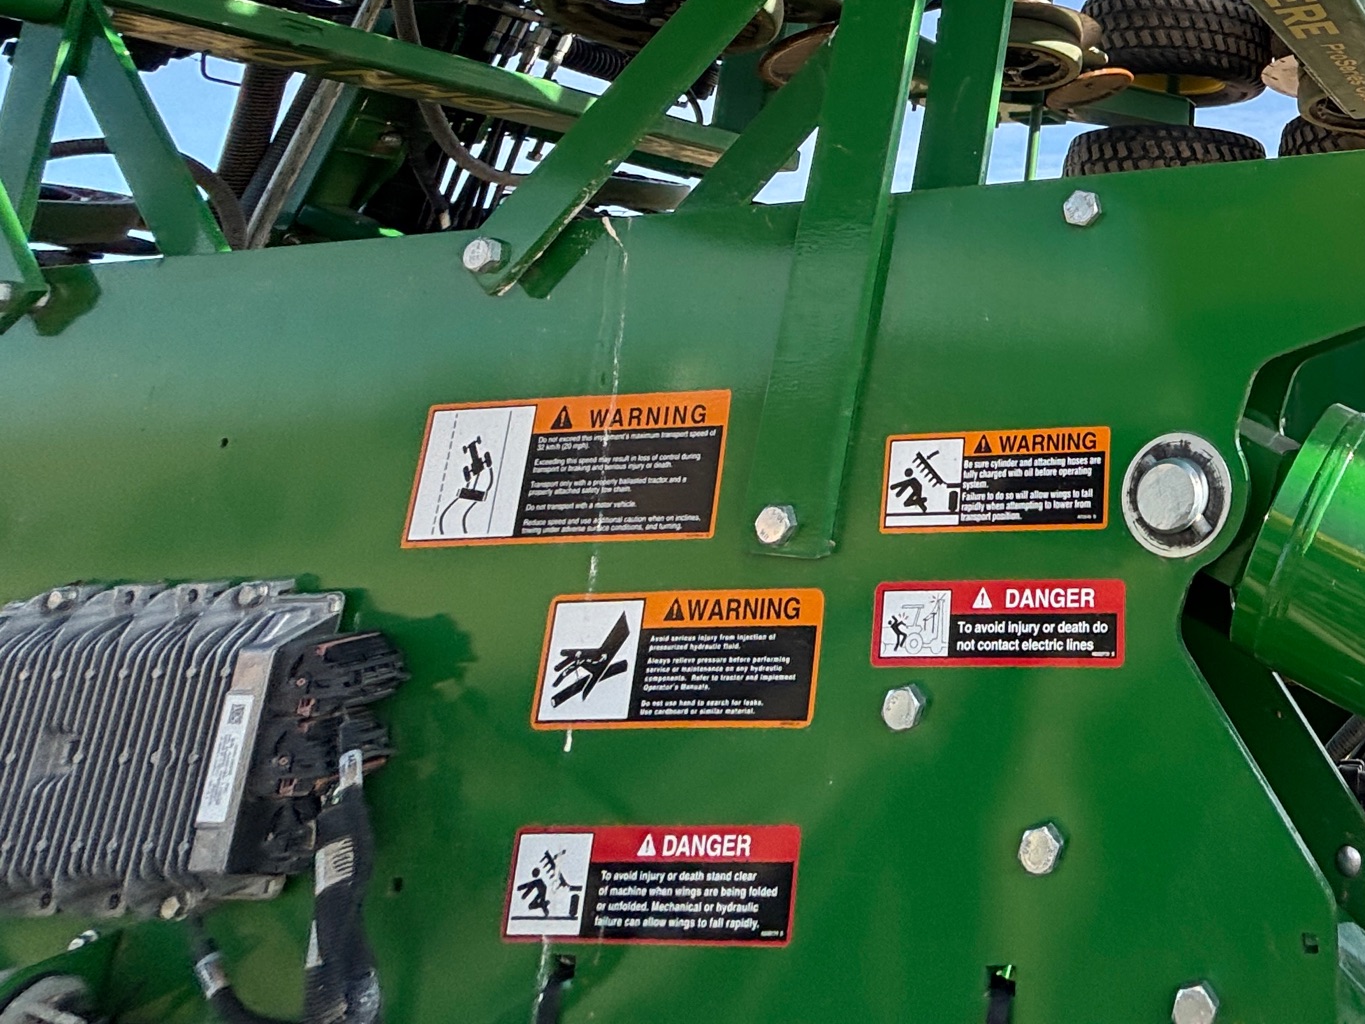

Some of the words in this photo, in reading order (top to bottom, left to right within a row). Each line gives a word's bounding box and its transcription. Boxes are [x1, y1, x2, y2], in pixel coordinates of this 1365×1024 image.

[590, 404, 707, 428] WARNING
[1000, 432, 1097, 452] WARNING
[963, 459, 973, 468] Be
[990, 458, 1018, 469] cylinder
[1019, 457, 1032, 466] and
[1033, 456, 1065, 468] attaching
[1067, 455, 1088, 465] hoses
[962, 469, 977, 480] fully
[978, 468, 1006, 480] charged
[1007, 468, 1022, 477] with
[1024, 468, 1033, 476] oil
[1034, 467, 1057, 476] before
[1058, 466, 1092, 477] operating
[962, 480, 989, 490] system.
[961, 491, 985, 500] Failure
[986, 491, 994, 500] to
[995, 491, 1004, 500] do
[1015, 490, 1028, 499] will
[1029, 490, 1049, 499] allow
[1050, 489, 1071, 500] wings
[1072, 489, 1079, 498] to
[1081, 488, 1093, 497] fall
[960, 502, 984, 512] rapidly
[985, 501, 1004, 510] when
[1005, 500, 1043, 511] attempting
[1044, 500, 1051, 508] to
[1052, 500, 1073, 508] lower
[1074, 499, 1091, 508] from
[1005, 588, 1095, 608] DANGER
[688, 597, 800, 621] WARNING
[957, 622, 971, 634] To
[974, 622, 1005, 634] avoid
[1008, 622, 1040, 636] injury
[1042, 624, 1055, 633] or
[1058, 621, 1090, 633] death
[1092, 621, 1108, 632] do
[956, 640, 975, 651] not
[978, 640, 1019, 651] contact
[1022, 638, 1064, 650] electric
[1066, 638, 1094, 650] lines
[662, 834, 752, 856] DANGER
[600, 870, 612, 880] To
[613, 870, 637, 880] avoid
[638, 870, 665, 883] injury
[666, 872, 677, 880] or
[678, 870, 704, 880] death
[706, 870, 732, 881] stand
[733, 870, 757, 881] clear
[598, 885, 608, 895] of
[609, 885, 647, 895] machine
[648, 886, 673, 896] when
[674, 886, 702, 898] wings
[703, 888, 718, 896] are
[719, 886, 746, 899] being
[748, 886, 778, 897] folded
[595, 902, 606, 910] or
[607, 900, 650, 911] unfolded.
[651, 901, 702, 912] Mechanical
[703, 904, 714, 912] or
[715, 902, 759, 915] hydraulic
[594, 915, 622, 926] failure
[624, 918, 640, 926] can
[642, 916, 666, 926] allow
[667, 916, 695, 929] wings
[697, 917, 707, 927] to
[709, 917, 724, 928] fall
[725, 917, 760, 930] rapidly.
